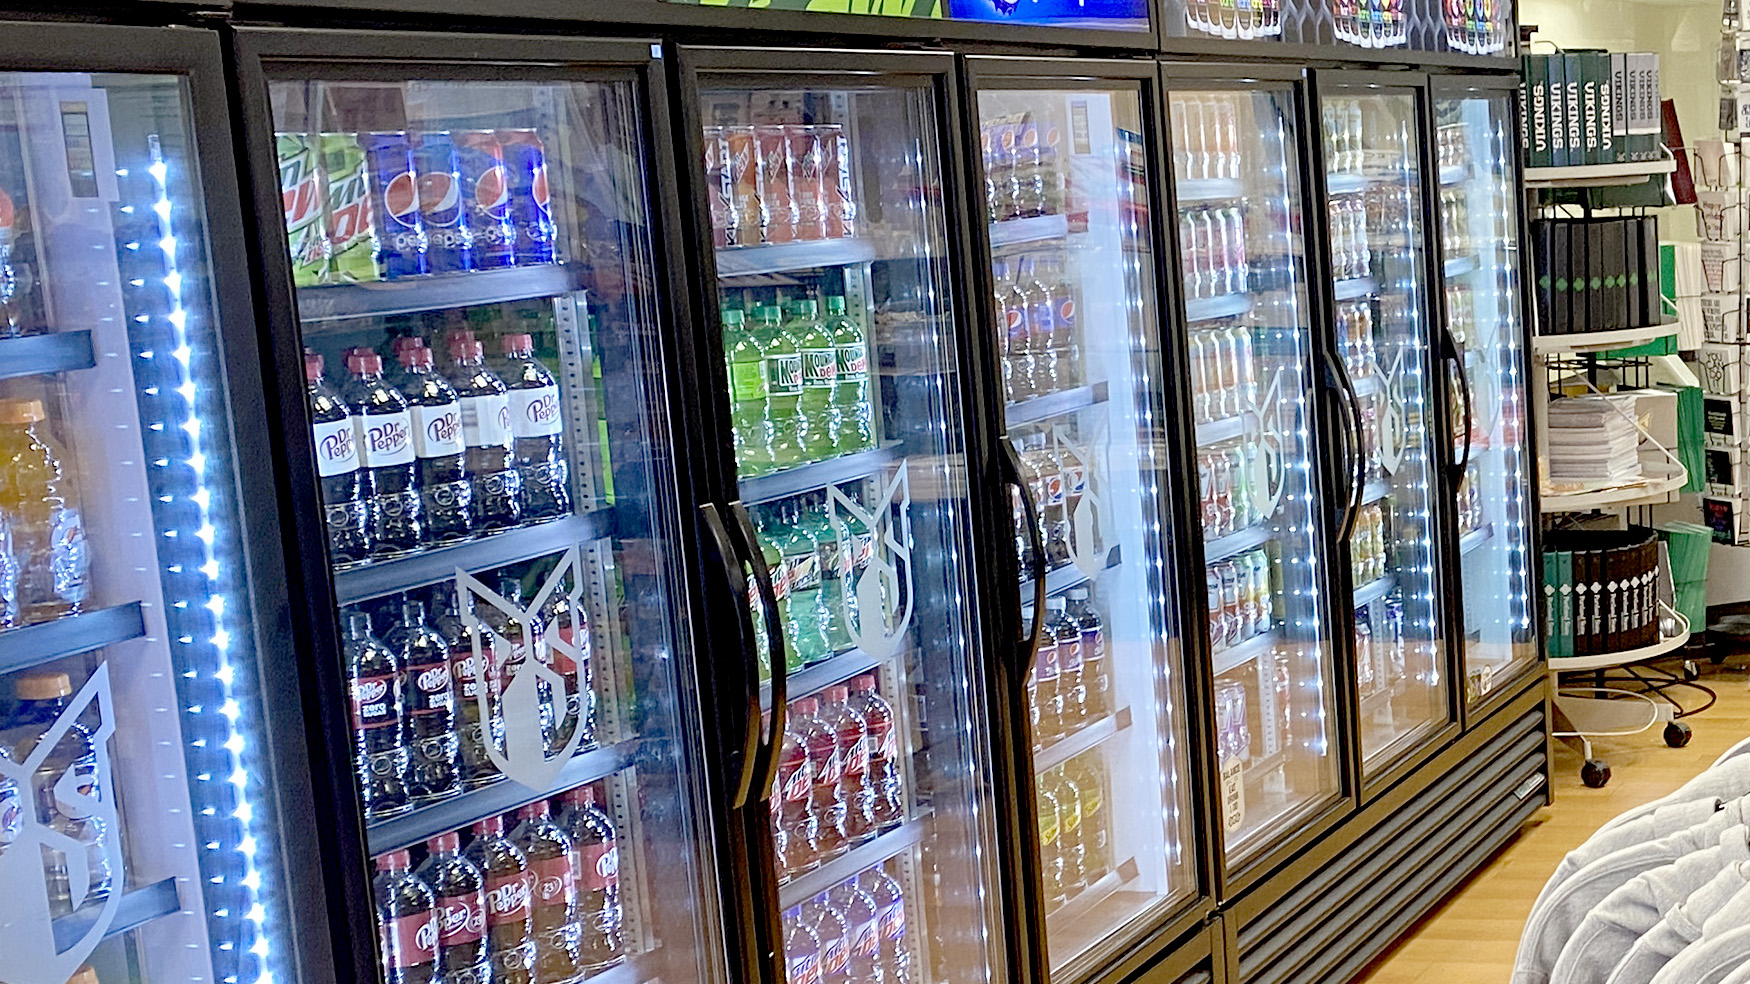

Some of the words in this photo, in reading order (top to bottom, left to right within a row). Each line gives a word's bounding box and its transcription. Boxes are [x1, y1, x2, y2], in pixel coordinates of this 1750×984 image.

[382, 422, 400, 437] Dr
[362, 704, 387, 712] zero
[502, 882, 518, 897] Dr
